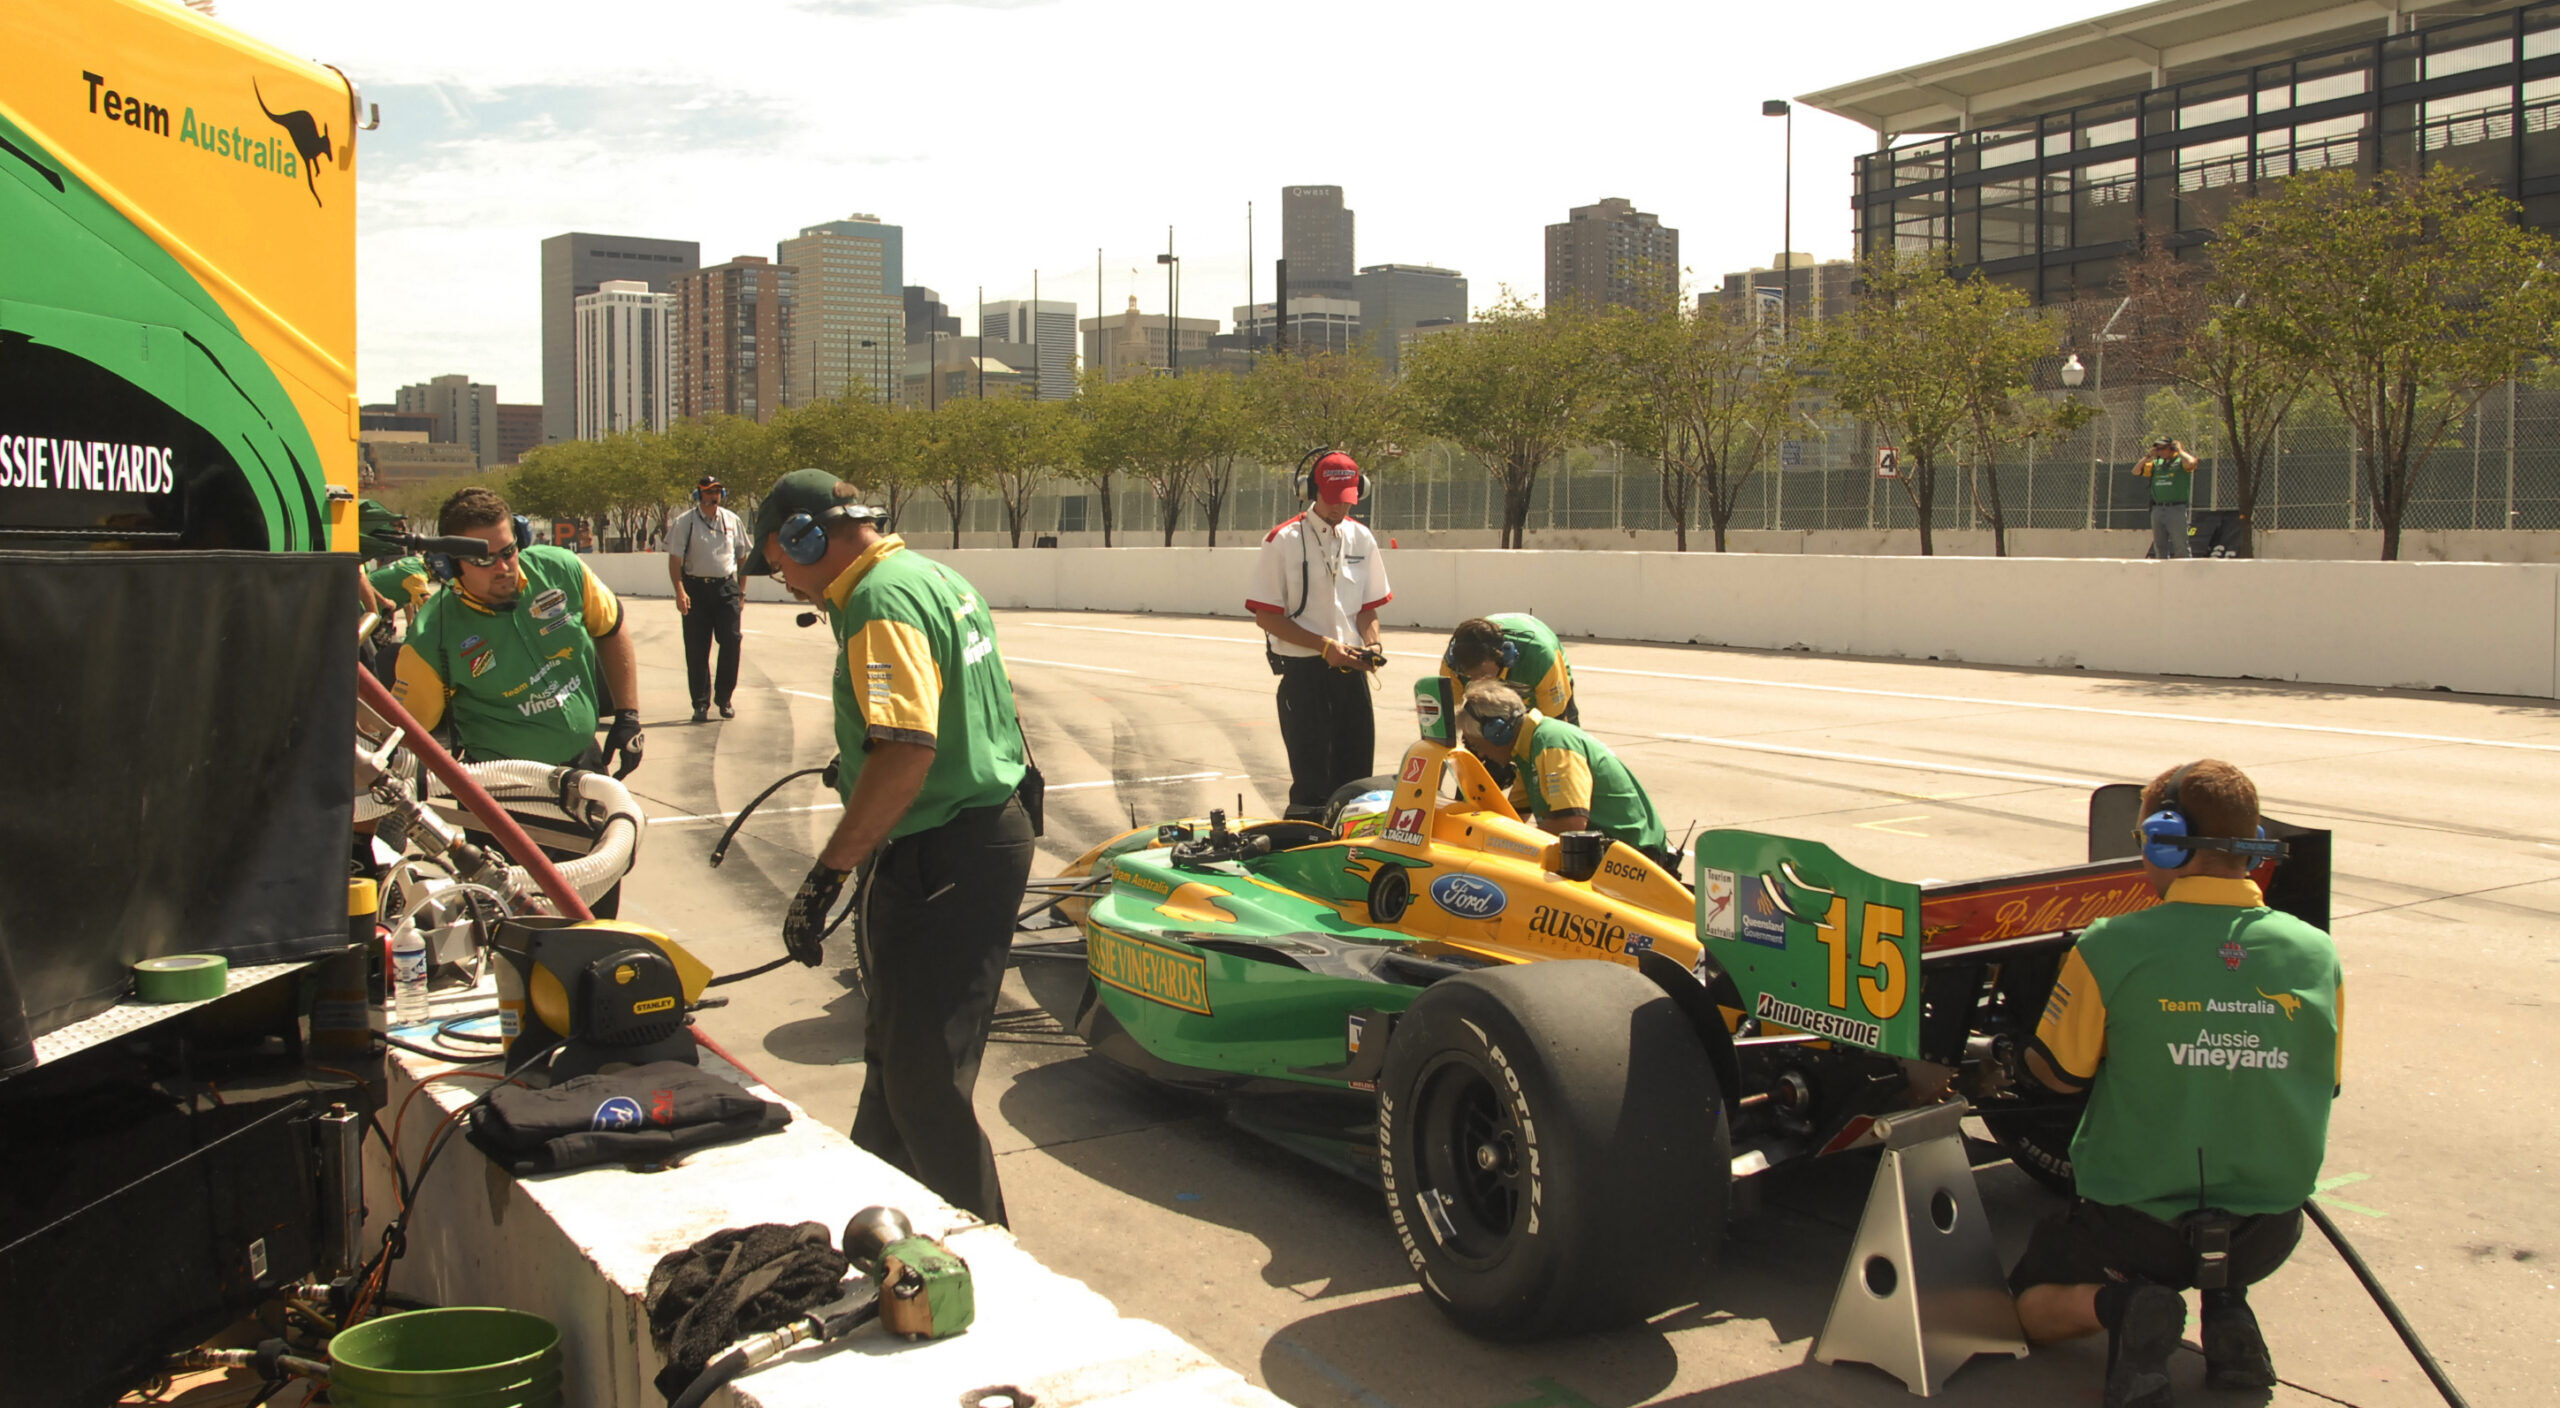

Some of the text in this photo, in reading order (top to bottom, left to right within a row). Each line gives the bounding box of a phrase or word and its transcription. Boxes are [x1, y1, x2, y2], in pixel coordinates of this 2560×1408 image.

[82, 70, 297, 179] Team Australia
[51, 438, 174, 494] VINEYARDS
[1881, 453, 1897, 473] 4
[555, 522, 576, 546] P
[502, 682, 529, 698] Team
[517, 674, 581, 717] Vineyards
[1113, 865, 1170, 896] Team Australia
[1604, 860, 1647, 883] BOSCH
[1707, 869, 1732, 882] Tourism
[1443, 877, 1493, 913] Ford
[1528, 904, 1626, 954] aussie
[1705, 922, 1735, 939] Australia
[1742, 914, 1785, 933] Queensland
[1743, 926, 1784, 944] Government
[1816, 894, 1907, 1020] 15
[1117, 942, 1202, 1006] VINEYARDS
[636, 999, 672, 1012] STANLEY
[1757, 992, 1879, 1047] BRIDGESTONE
[2158, 998, 2276, 1014] Team Australia
[2196, 1028, 2261, 1048] Aussie
[2167, 1043, 2289, 1071] Vineyards
[1490, 1045, 1542, 1235] POTENZA
[1380, 1090, 1427, 1272] BRIDGESTONE
